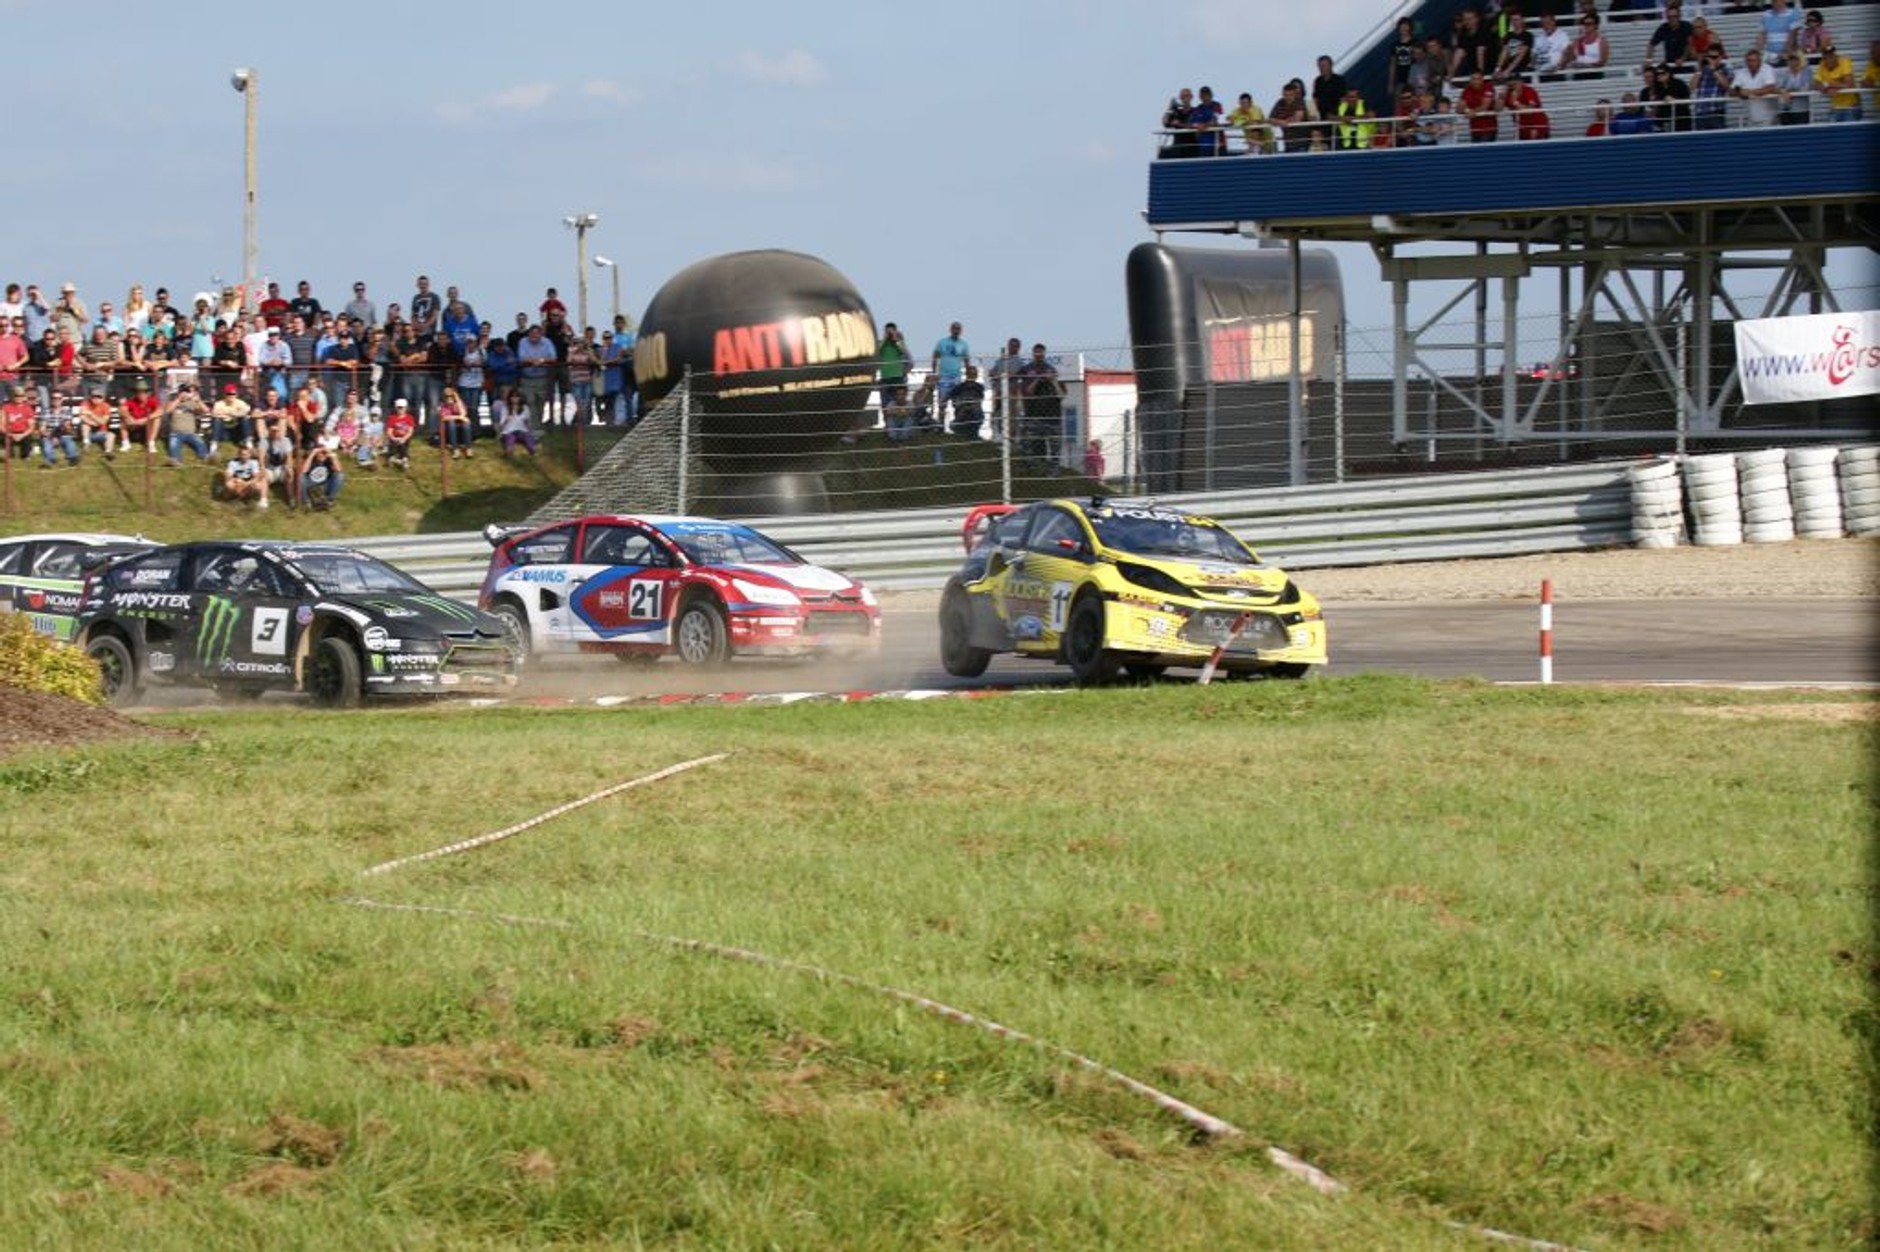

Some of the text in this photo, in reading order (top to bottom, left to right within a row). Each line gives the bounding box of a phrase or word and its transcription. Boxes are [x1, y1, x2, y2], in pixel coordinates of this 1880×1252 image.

[109, 592, 191, 609] MONSTER
[631, 582, 660, 618] 21
[257, 617, 281, 641] 3
